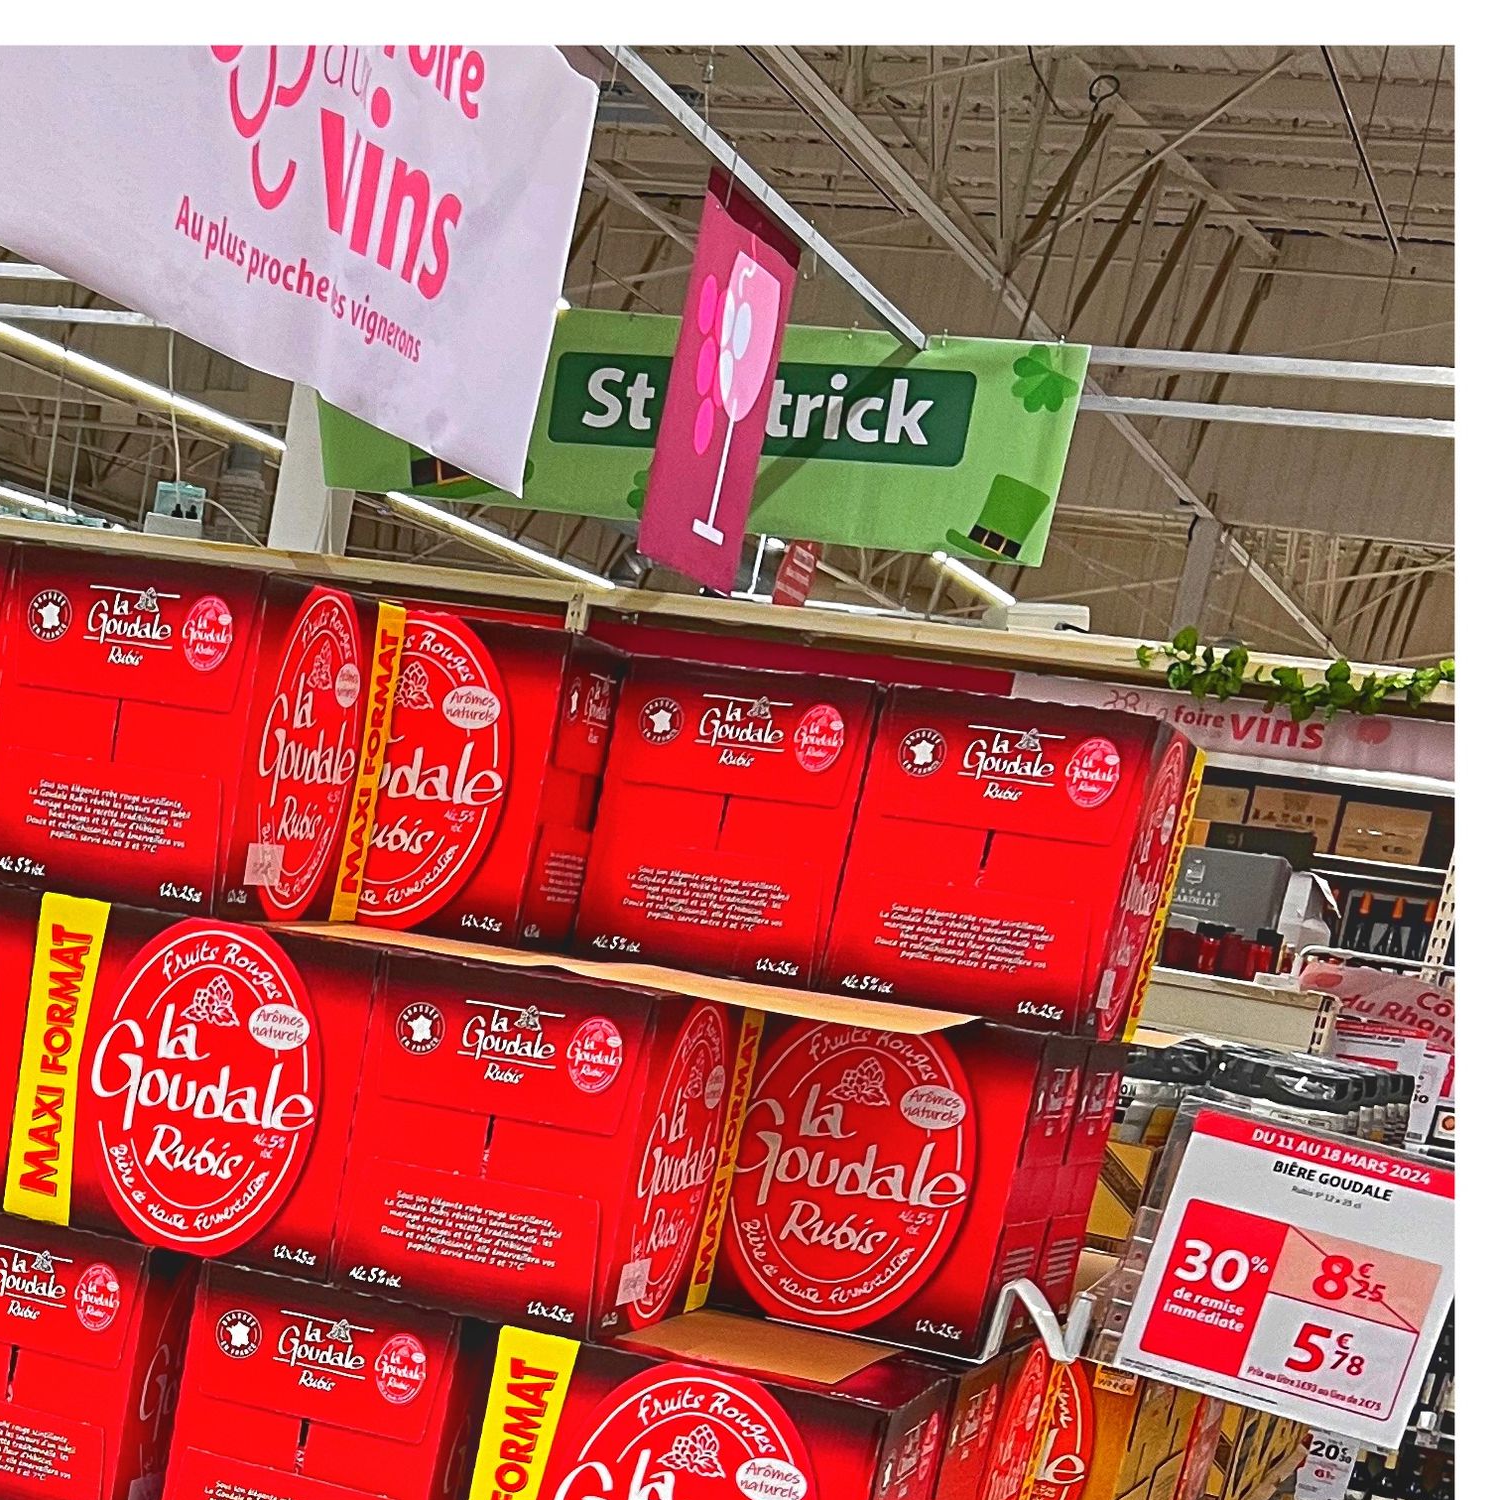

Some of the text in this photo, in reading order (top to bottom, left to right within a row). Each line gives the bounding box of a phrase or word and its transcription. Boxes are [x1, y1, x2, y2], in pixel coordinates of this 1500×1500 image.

[175, 195, 203, 241] Au
[205, 217, 246, 266] plus
[247, 246, 330, 302] proche
[352, 294, 422, 363] vignerons
[580, 366, 934, 447] St trick
[445, 704, 496, 723] naturels
[449, 690, 496, 708] Arômes
[1174, 702, 1325, 751] foire vins
[342, 628, 403, 894] MAXI FORMAT
[963, 740, 1056, 781] Goudale
[20, 925, 94, 1196] MAXI FORMAT
[91, 1019, 314, 1131] Goudale
[145, 1125, 243, 1180] Rubis
[1252, 1129, 1431, 1186] DU 11 AU 18 MARS 2024
[1319, 1172, 1393, 1202] GOUDALE
[1174, 1239, 1269, 1292] 30%
[1163, 1301, 1245, 1333] immédiate
[1173, 1287, 1245, 1316] de remise
[637, 1391, 777, 1454] Fruits Rouges
[740, 1478, 800, 1500] naturels
[745, 1461, 801, 1485] Arômes
